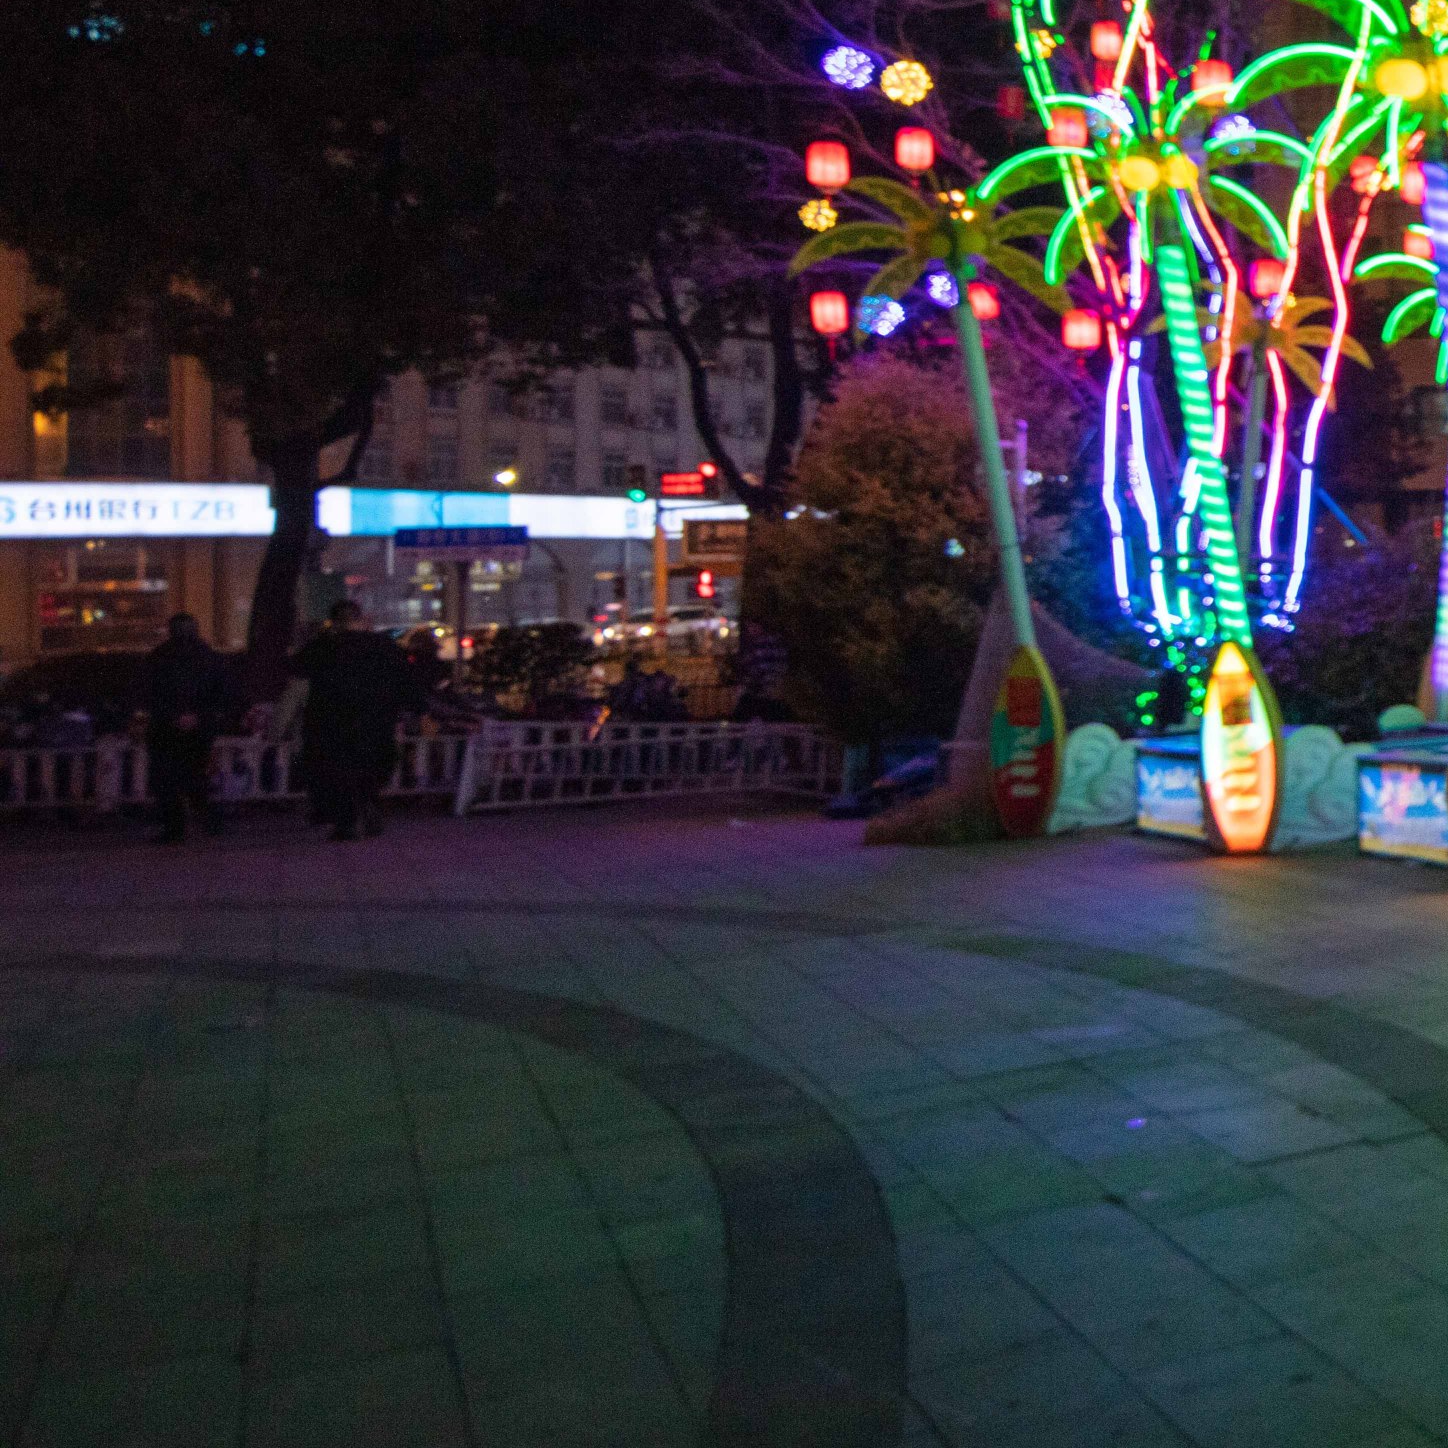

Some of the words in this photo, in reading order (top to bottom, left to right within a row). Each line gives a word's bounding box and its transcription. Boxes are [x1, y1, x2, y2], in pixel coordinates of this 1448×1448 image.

[29, 498, 158, 522] 台州银行
[172, 499, 236, 521] TZB
